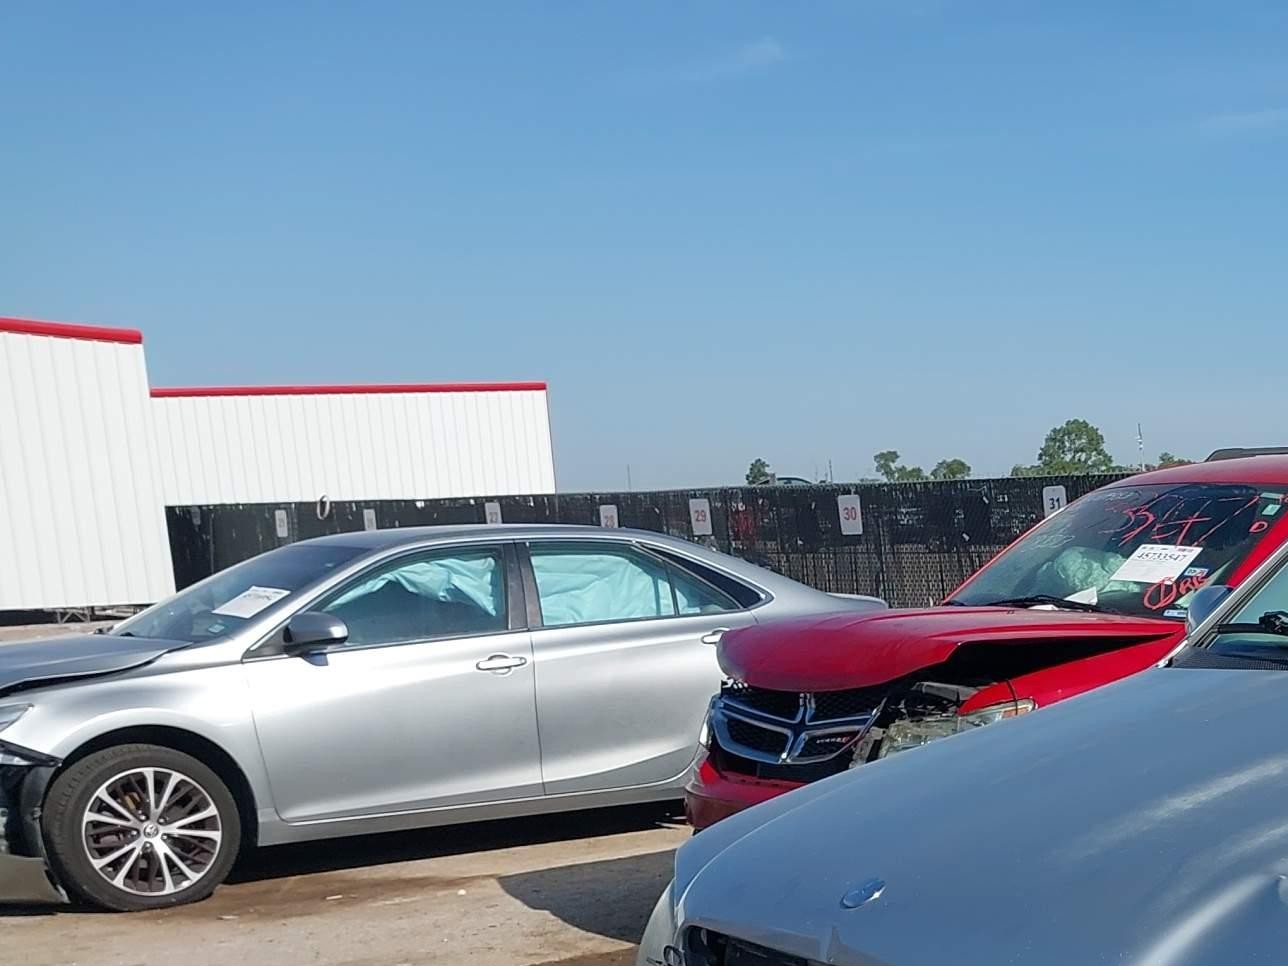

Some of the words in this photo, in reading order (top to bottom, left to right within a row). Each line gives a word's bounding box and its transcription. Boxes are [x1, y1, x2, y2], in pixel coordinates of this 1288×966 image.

[1048, 497, 1061, 510] 31
[694, 510, 707, 523] 29
[843, 507, 857, 521] 30
